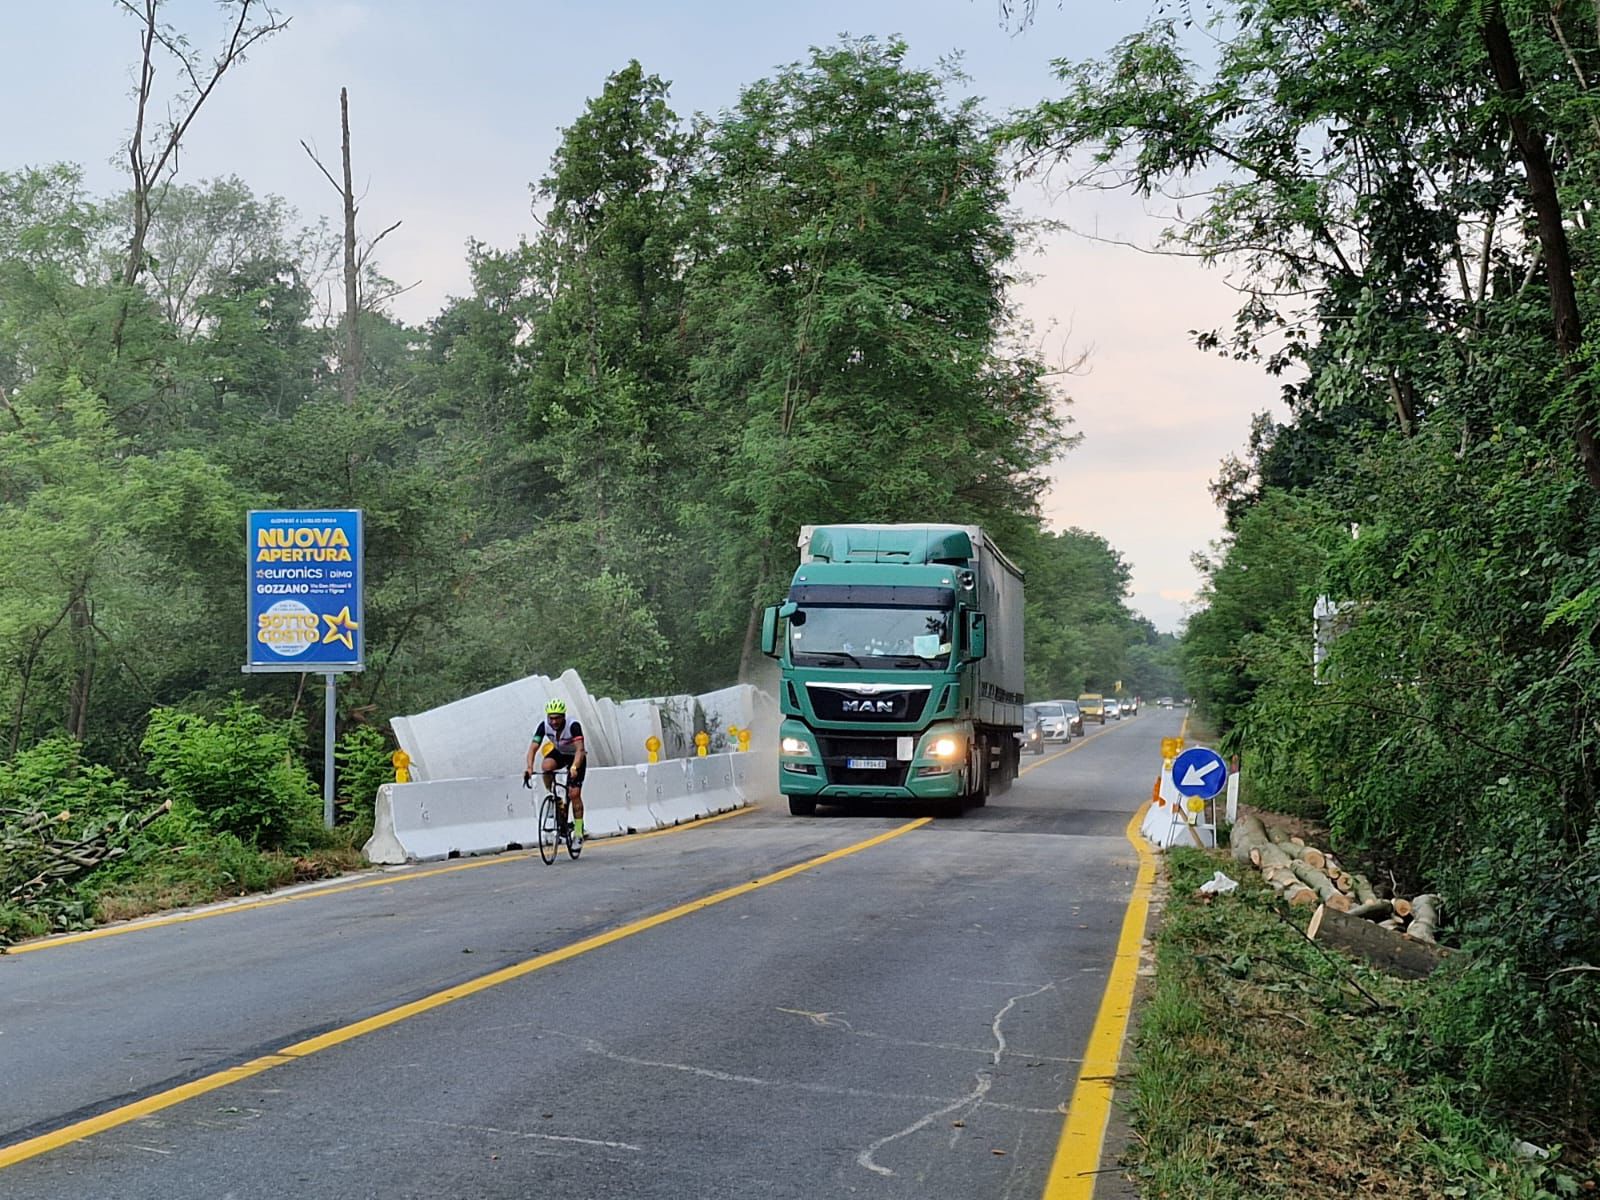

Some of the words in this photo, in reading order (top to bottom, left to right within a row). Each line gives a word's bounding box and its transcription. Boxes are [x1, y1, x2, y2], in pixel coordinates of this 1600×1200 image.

[258, 527, 350, 547] NUOVA
[256, 548, 352, 562] APERTURA
[264, 566, 323, 579] euronics
[257, 583, 309, 594] GOZZANO
[258, 613, 319, 629] SOTTO
[257, 628, 320, 643] COSTO
[842, 700, 893, 712] MAN
